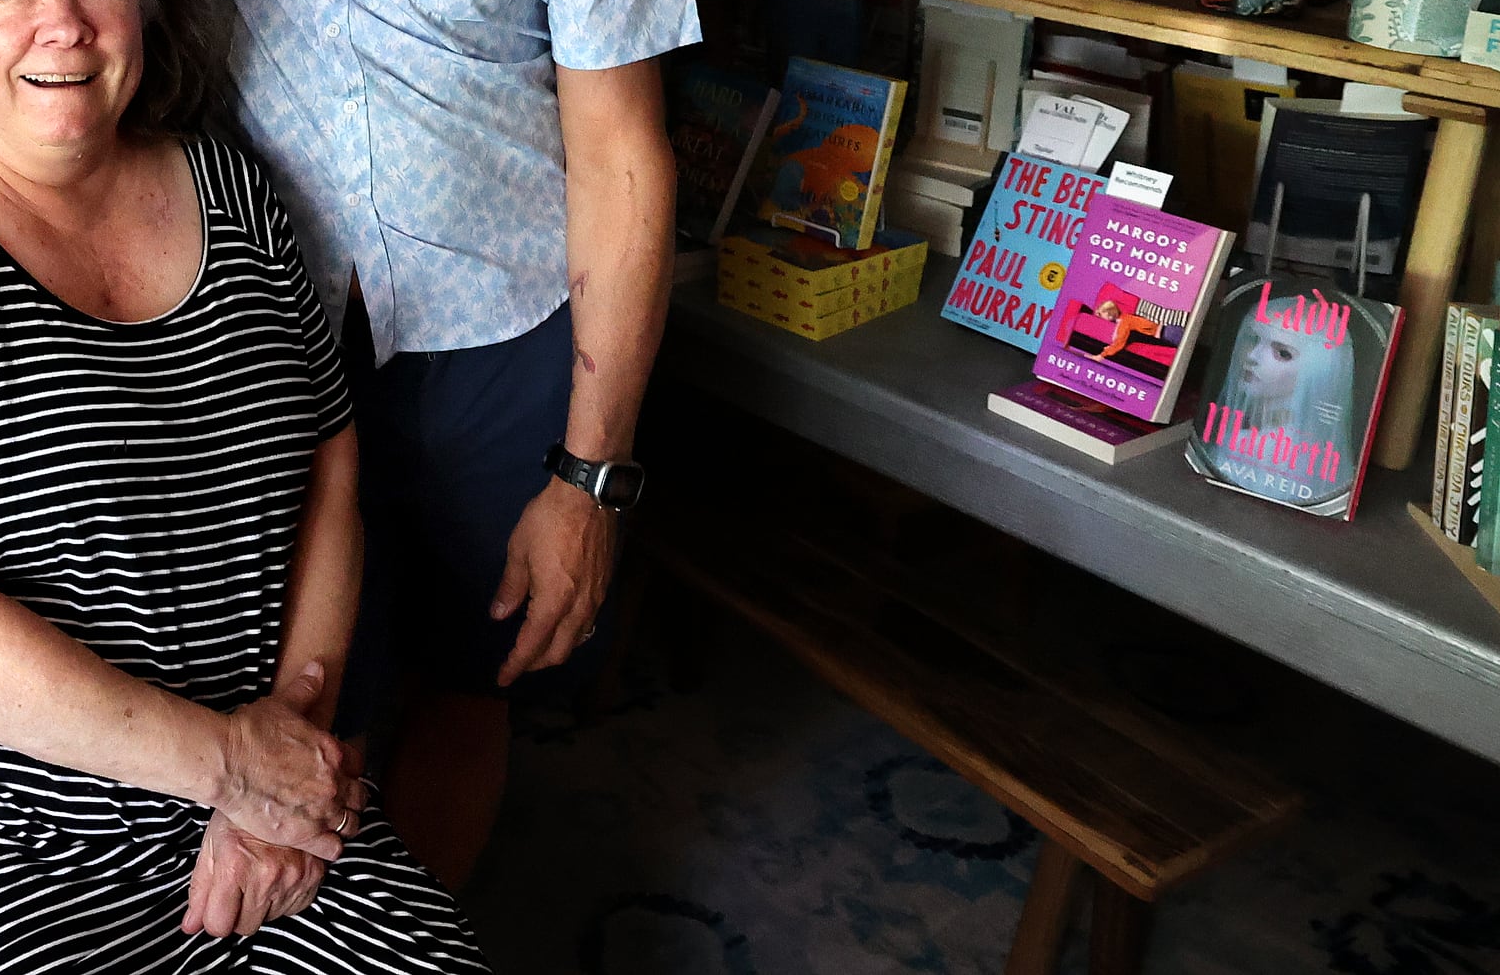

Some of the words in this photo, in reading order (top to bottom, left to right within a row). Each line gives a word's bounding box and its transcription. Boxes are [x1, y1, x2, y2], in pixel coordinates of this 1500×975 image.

[1003, 157, 1051, 198] THE
[1052, 173, 1104, 212] BEE
[1004, 200, 1087, 250] STING
[1106, 220, 1188, 253] MARGO'S
[965, 240, 1027, 289] PAUL
[1089, 234, 1125, 253] GOT
[1130, 246, 1195, 275] MONEY
[1090, 253, 1180, 293] TROUBLES
[948, 278, 1053, 339] MURRAY
[1255, 282, 1351, 349] Lady
[1466, 321, 1478, 350] ALL
[1047, 355, 1081, 375] RUFI
[1087, 368, 1147, 401] THORPE
[1459, 349, 1474, 401] FOURS
[1202, 402, 1341, 483] Macbeth
[1449, 423, 1468, 495] MIRANDA
[1220, 461, 1257, 482] AVA
[1265, 473, 1314, 500] REID
[1445, 497, 1460, 538] JULY
